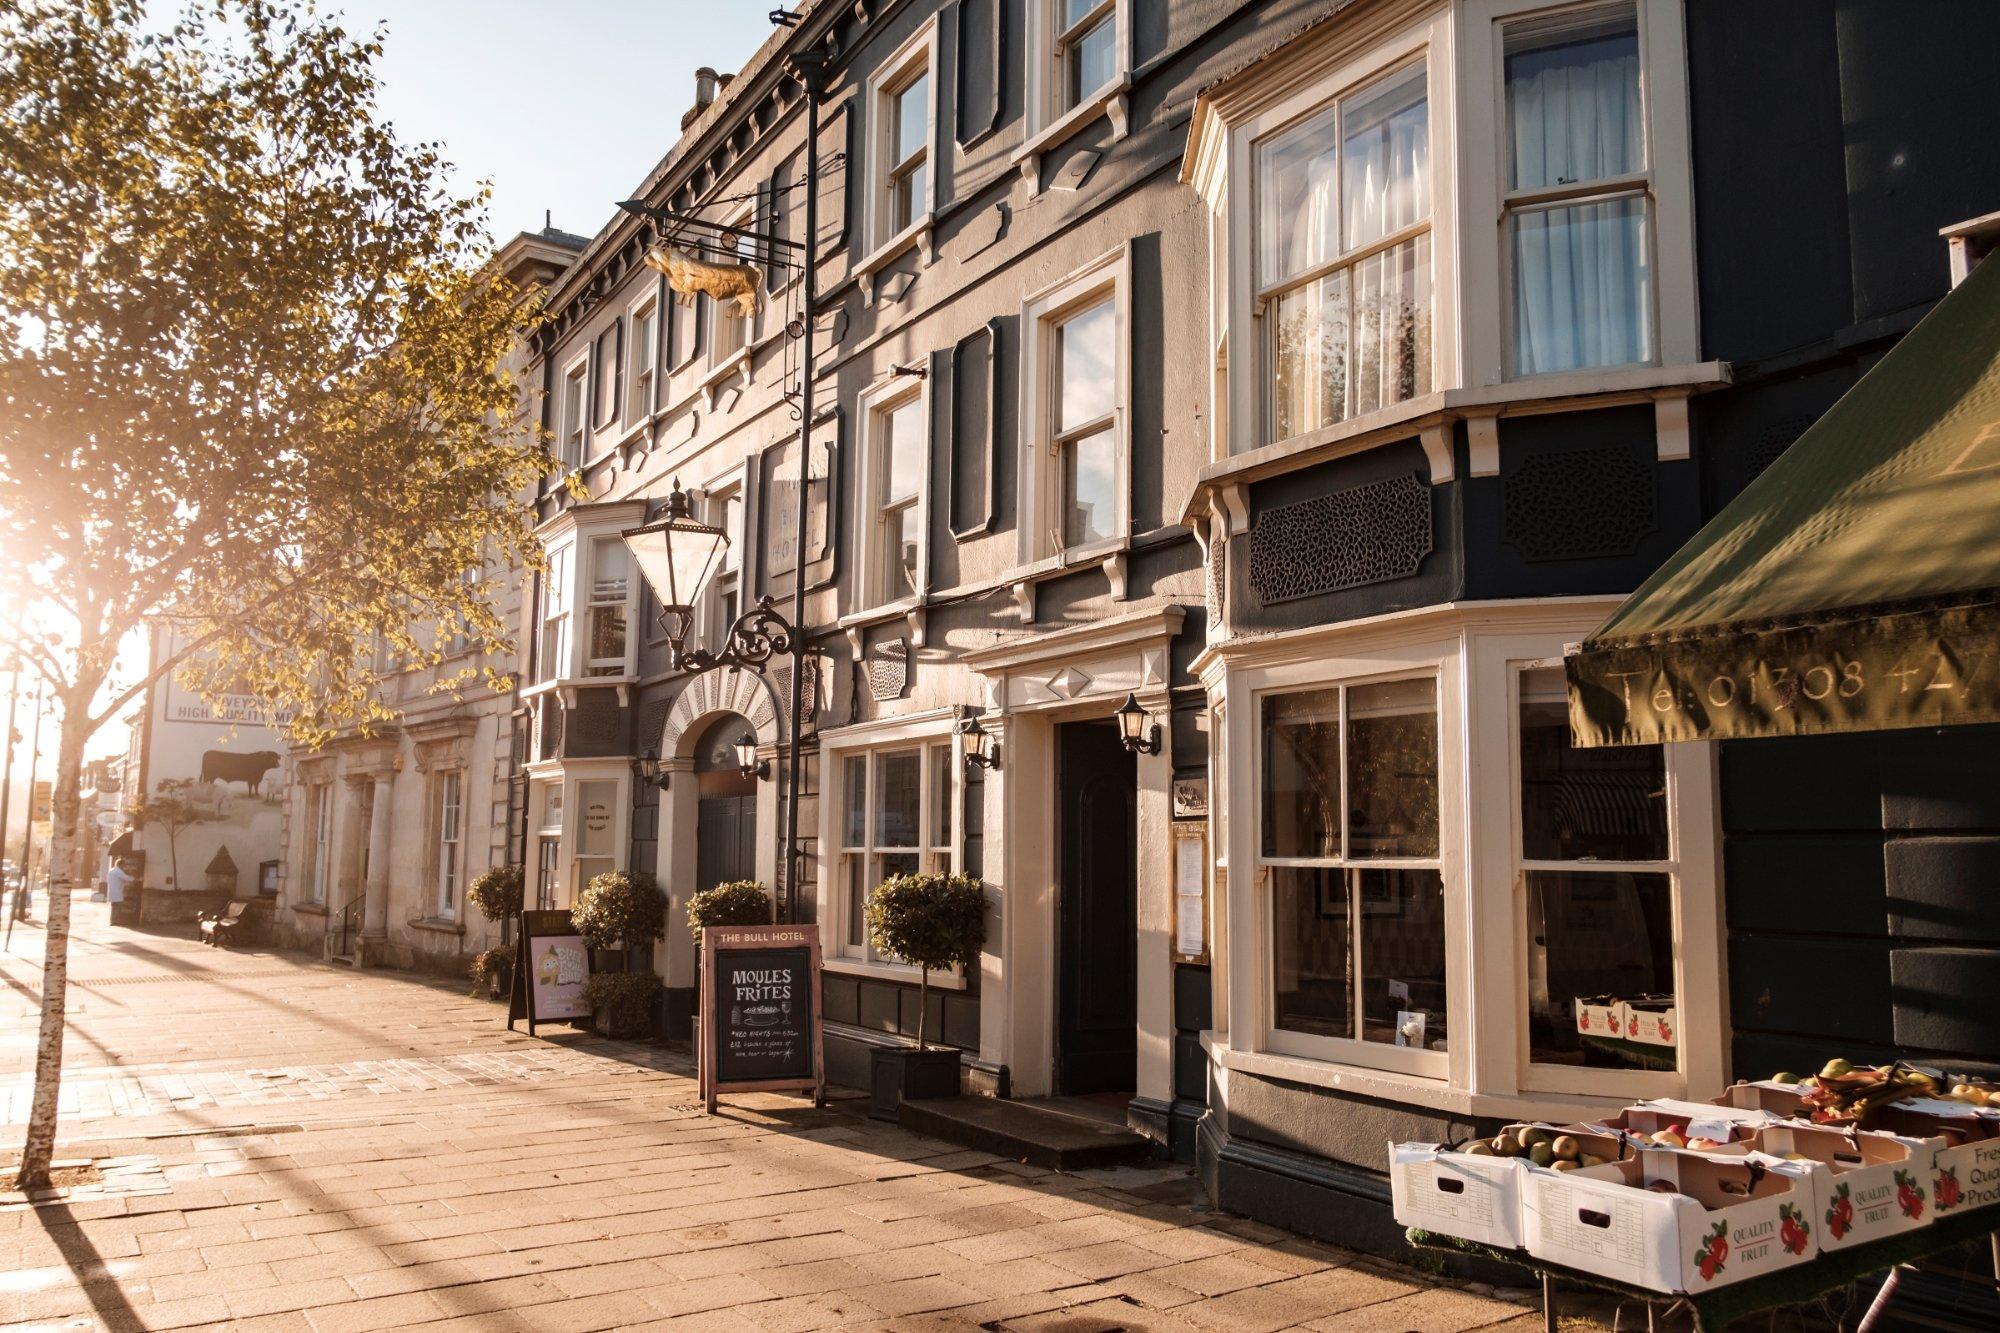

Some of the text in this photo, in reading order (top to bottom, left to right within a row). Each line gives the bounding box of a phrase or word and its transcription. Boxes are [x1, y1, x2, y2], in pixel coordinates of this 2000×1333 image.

[178, 706, 209, 719] HIGH
[721, 932, 804, 942] THE BULL HOTEL
[732, 969, 792, 985] MOULES
[1855, 1184, 1892, 1206] QUALITY
[1864, 1207, 1889, 1224] FRUIT
[1733, 1220, 1775, 1244] QUALITY
[1741, 1245, 1769, 1263] FRUIT
